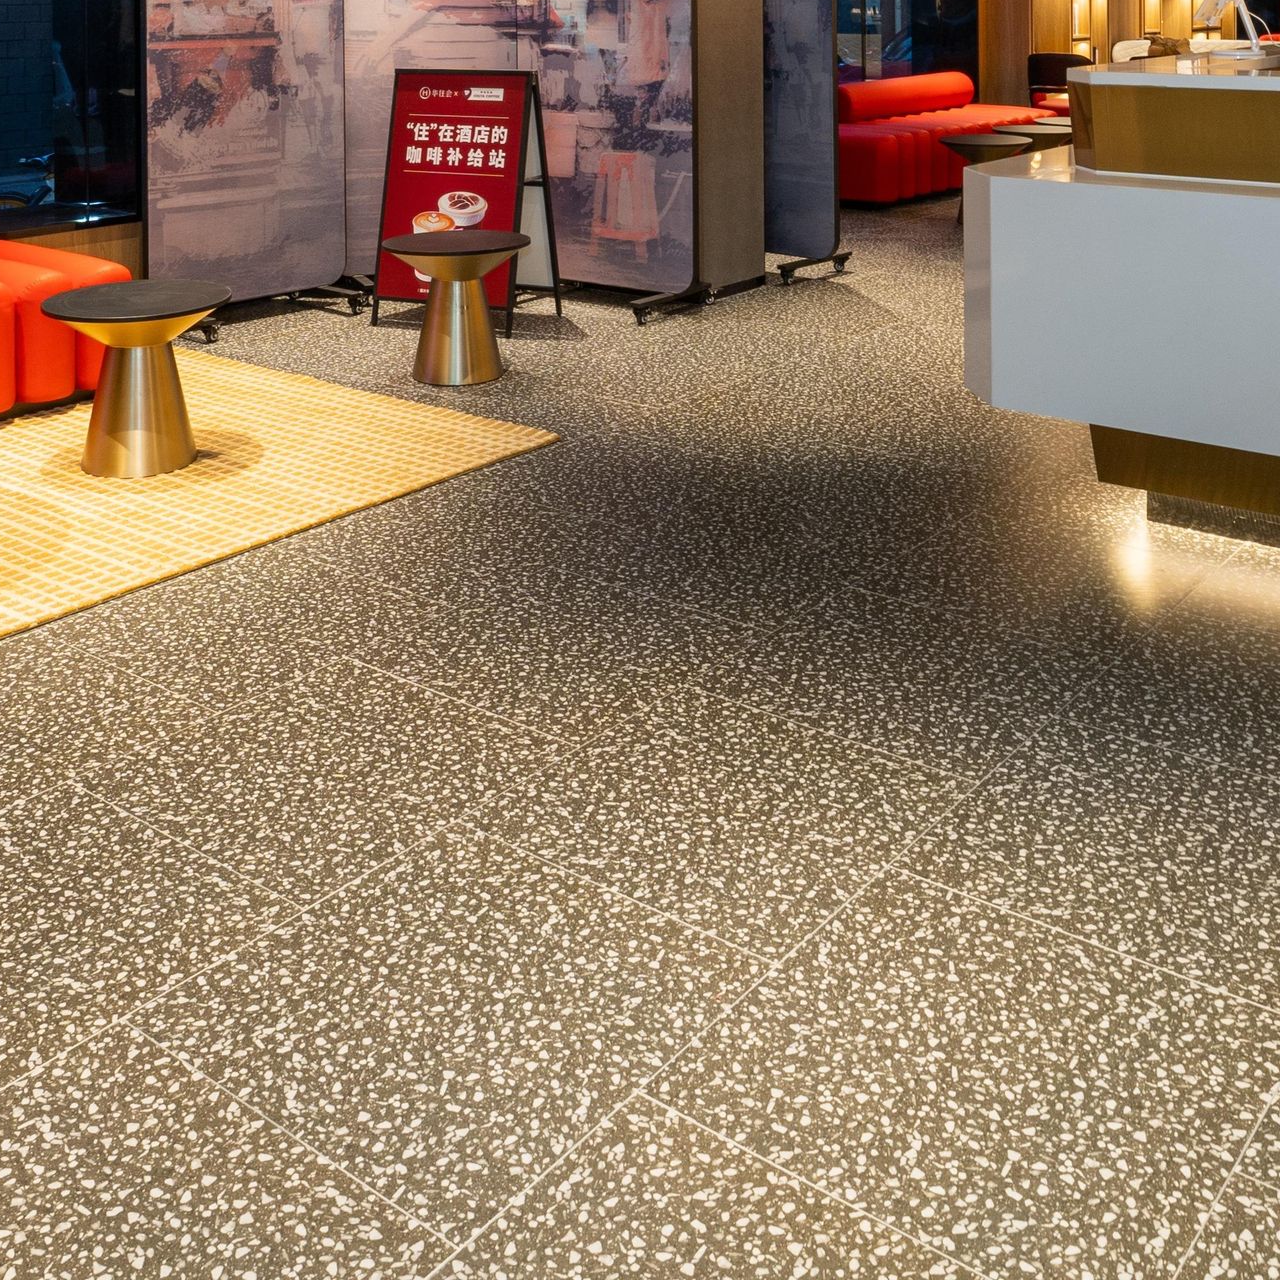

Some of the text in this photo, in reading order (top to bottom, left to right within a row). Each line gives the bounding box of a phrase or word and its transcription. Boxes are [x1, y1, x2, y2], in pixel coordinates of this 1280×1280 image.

[406, 122, 508, 144] “住”在酒店的
[405, 146, 506, 168] 咖啡补给站
